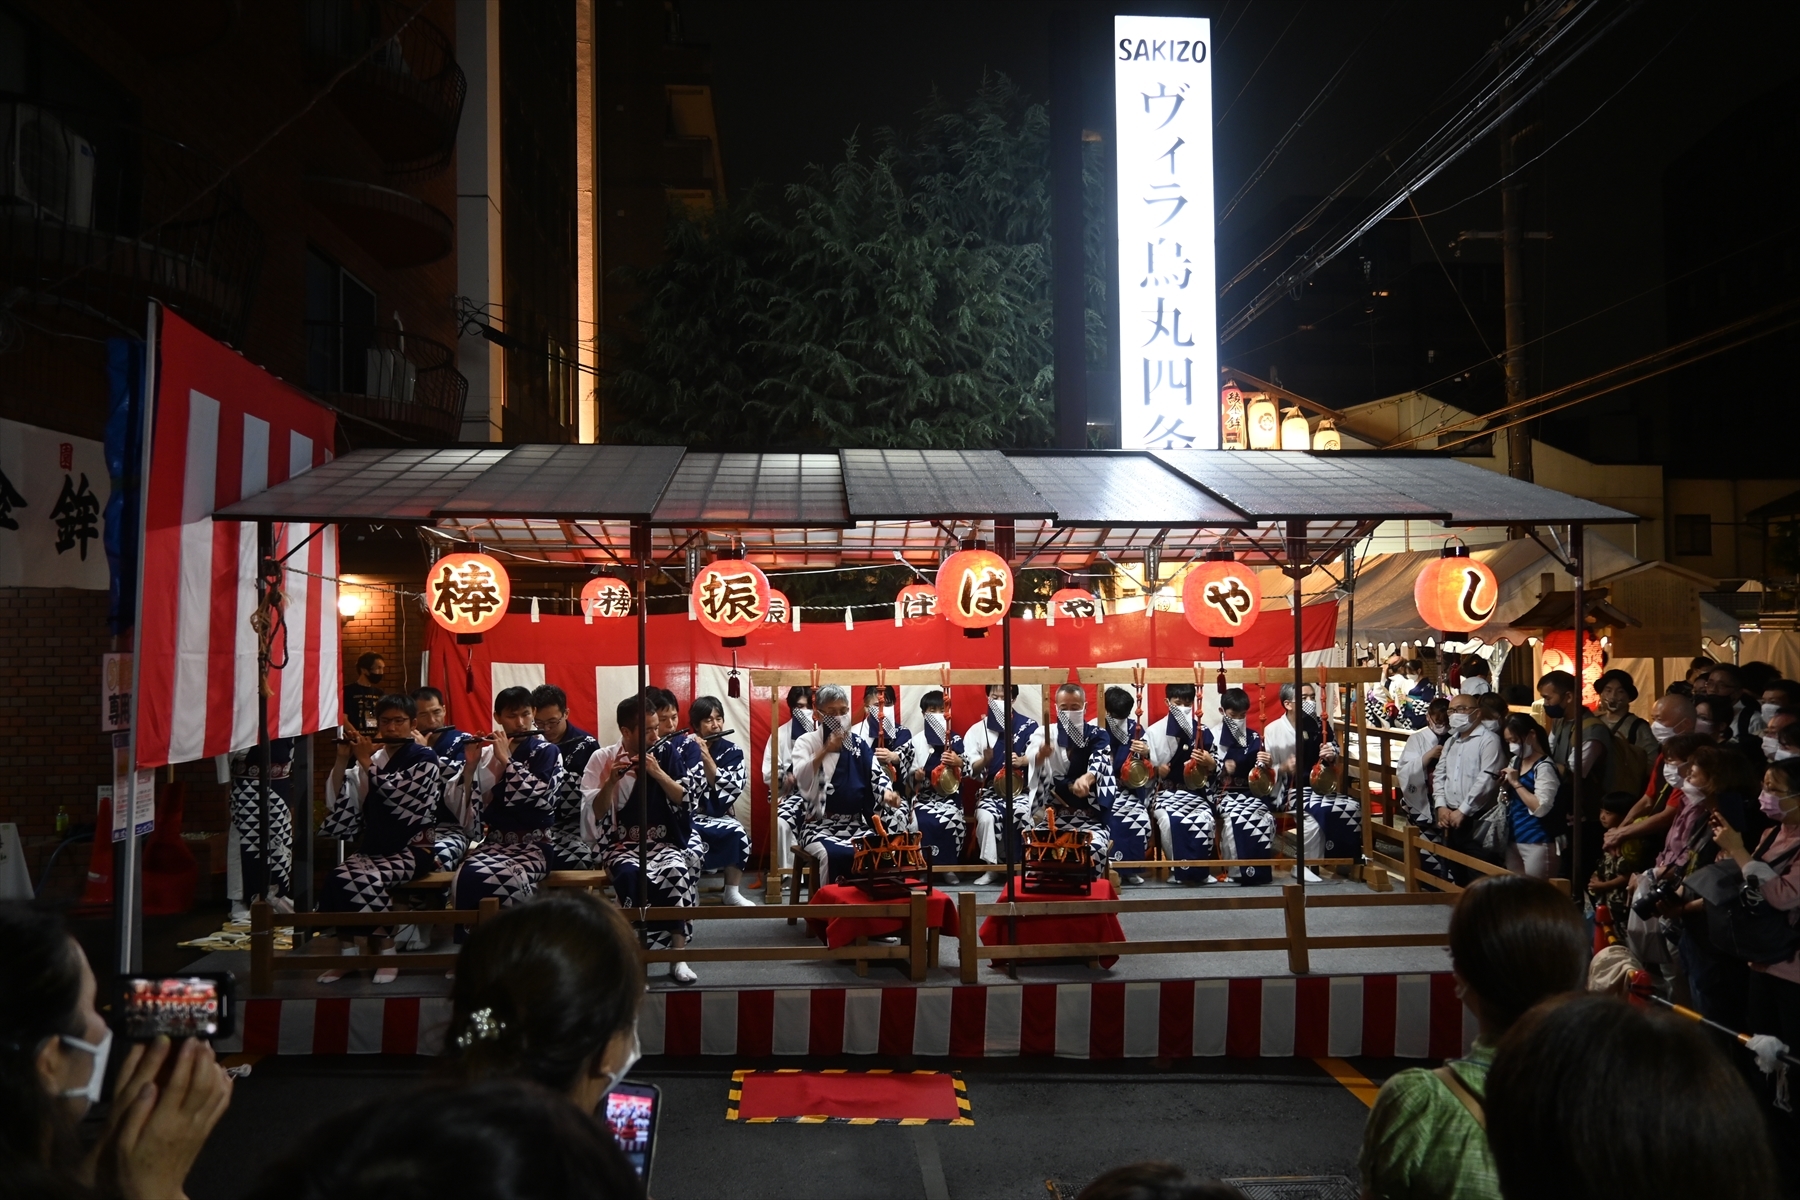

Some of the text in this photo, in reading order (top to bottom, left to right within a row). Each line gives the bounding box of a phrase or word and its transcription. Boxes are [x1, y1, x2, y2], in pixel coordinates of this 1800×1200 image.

[1118, 38, 1207, 63] SAKIZO
[434, 564, 500, 623] 棒
[702, 573, 760, 623] 振
[961, 571, 1005, 614] ば
[1207, 580, 1251, 622] や
[1463, 570, 1496, 621] し
